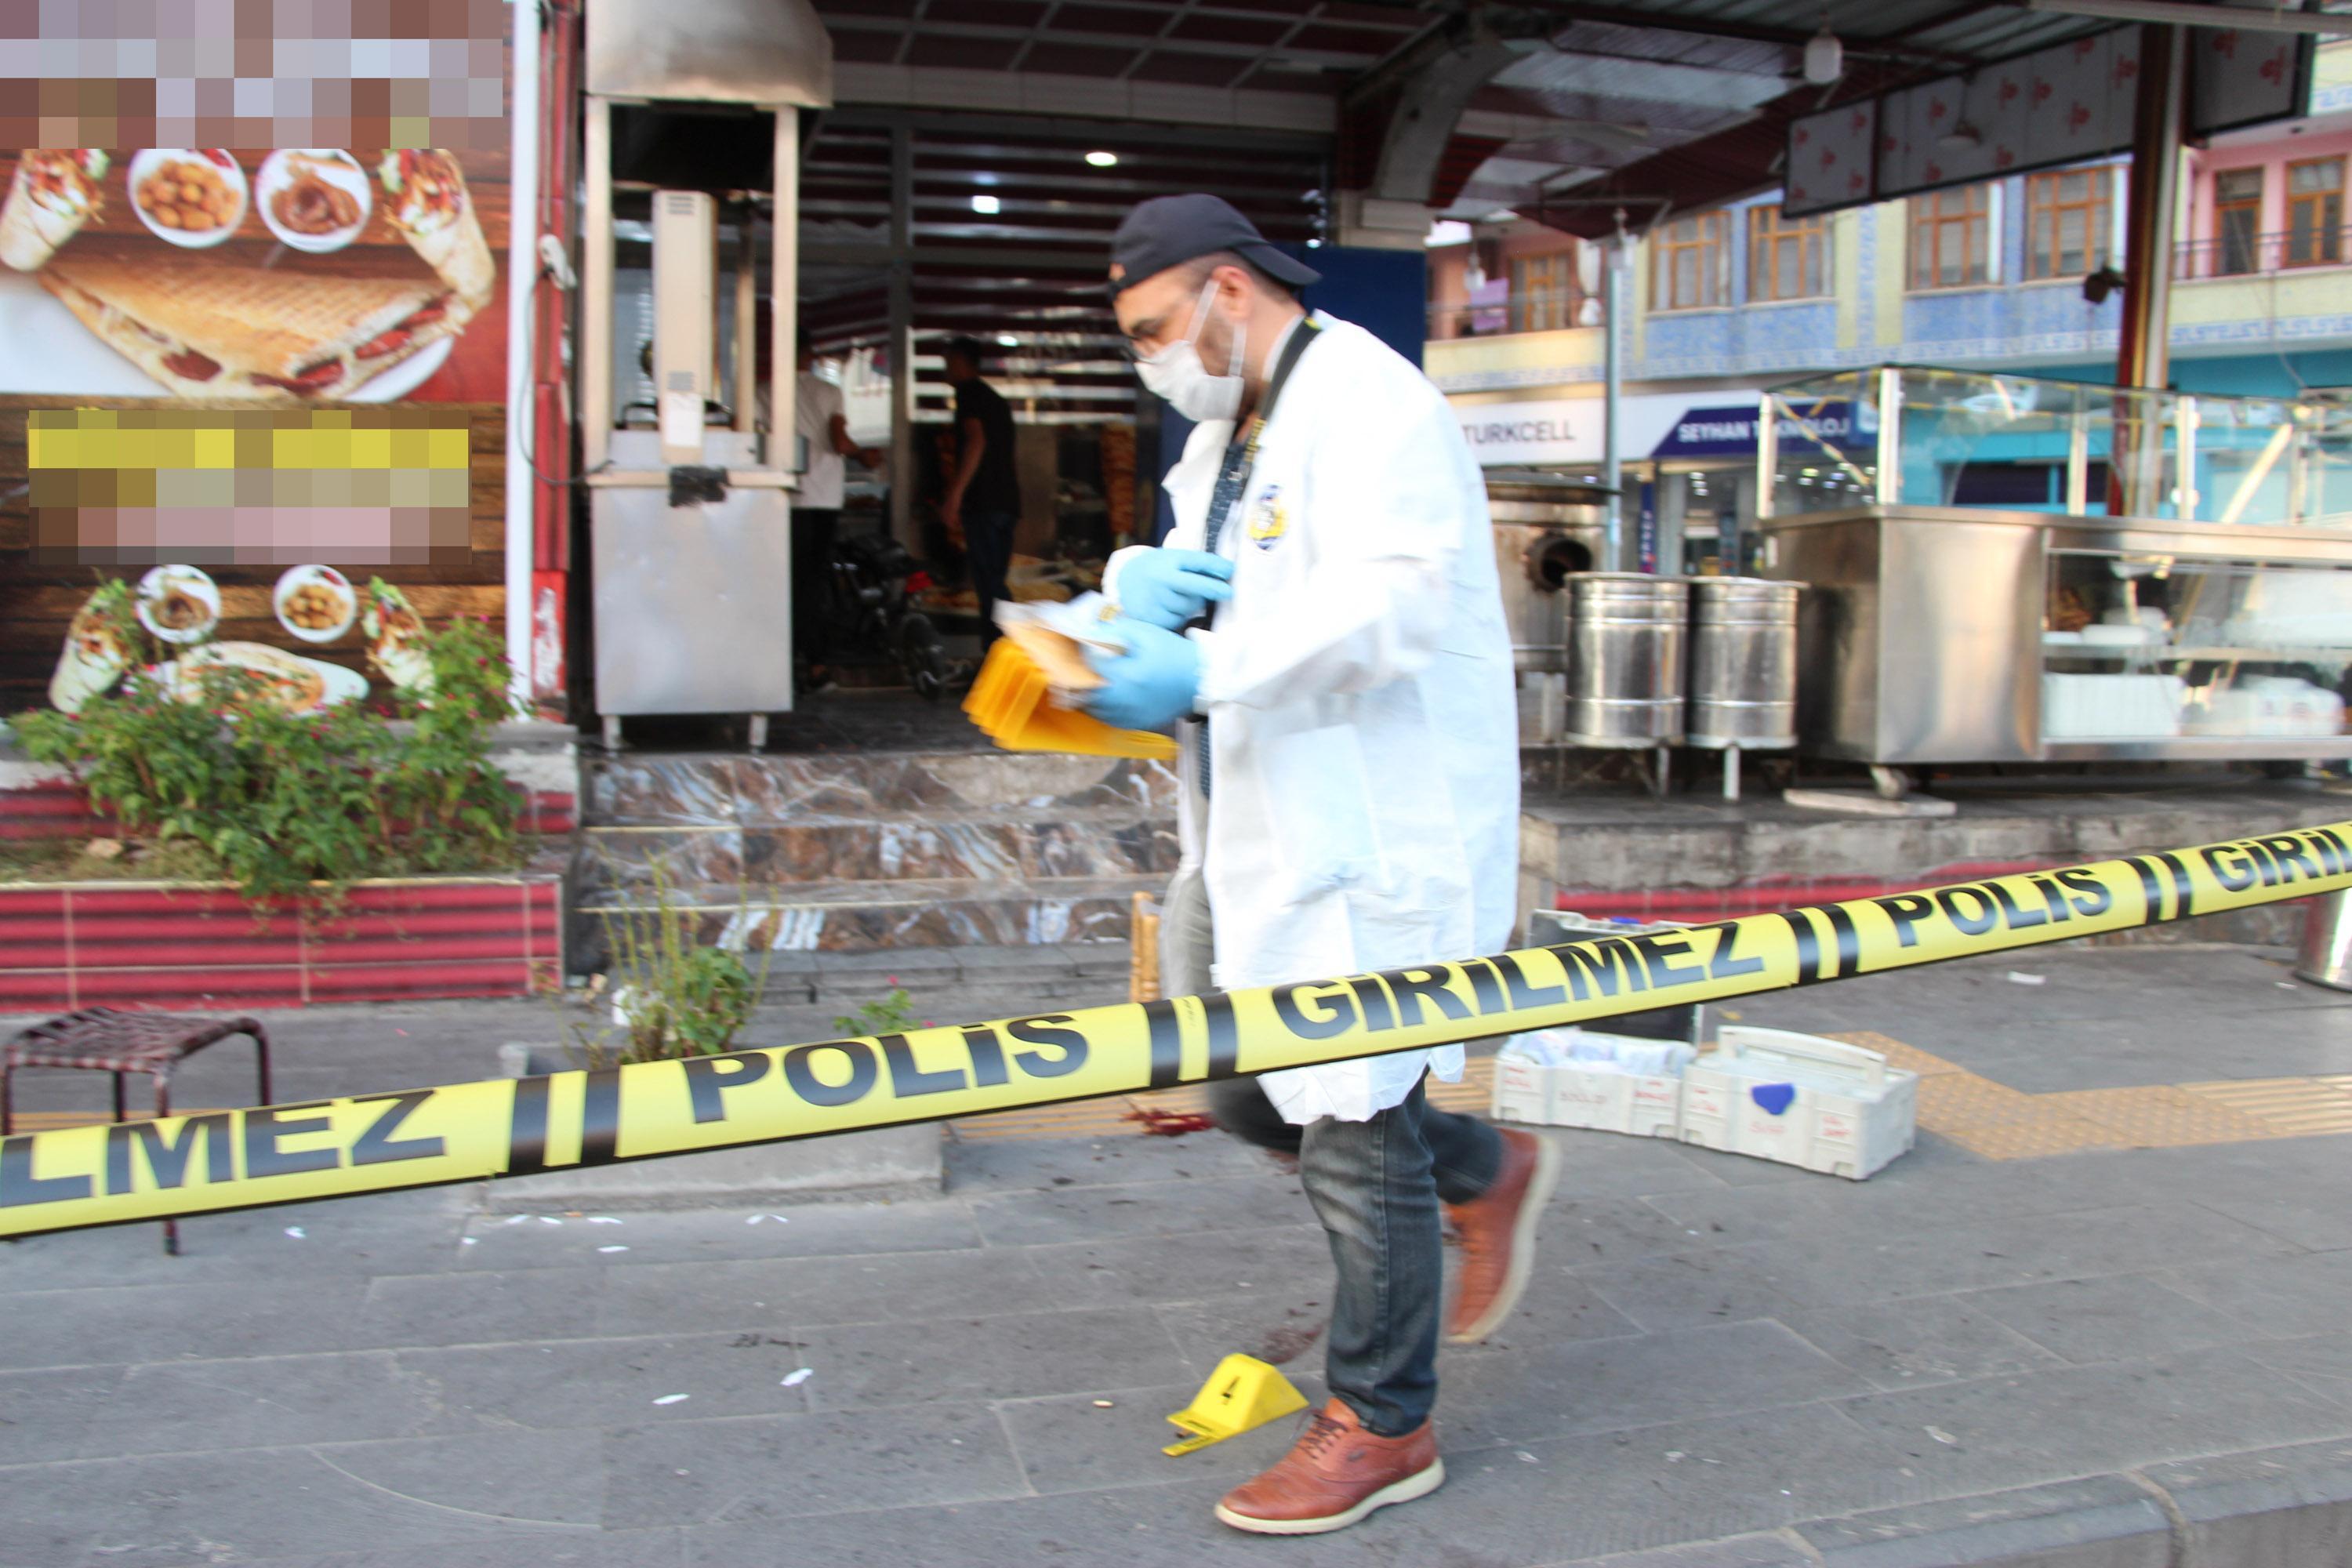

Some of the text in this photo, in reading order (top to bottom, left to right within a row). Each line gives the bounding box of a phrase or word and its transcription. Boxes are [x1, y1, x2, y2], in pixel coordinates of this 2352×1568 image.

[1461, 419, 1577, 444] TURKCELL
[1677, 420, 1750, 443] SEYHAN
[1, 1087, 446, 1208] LMEZ
